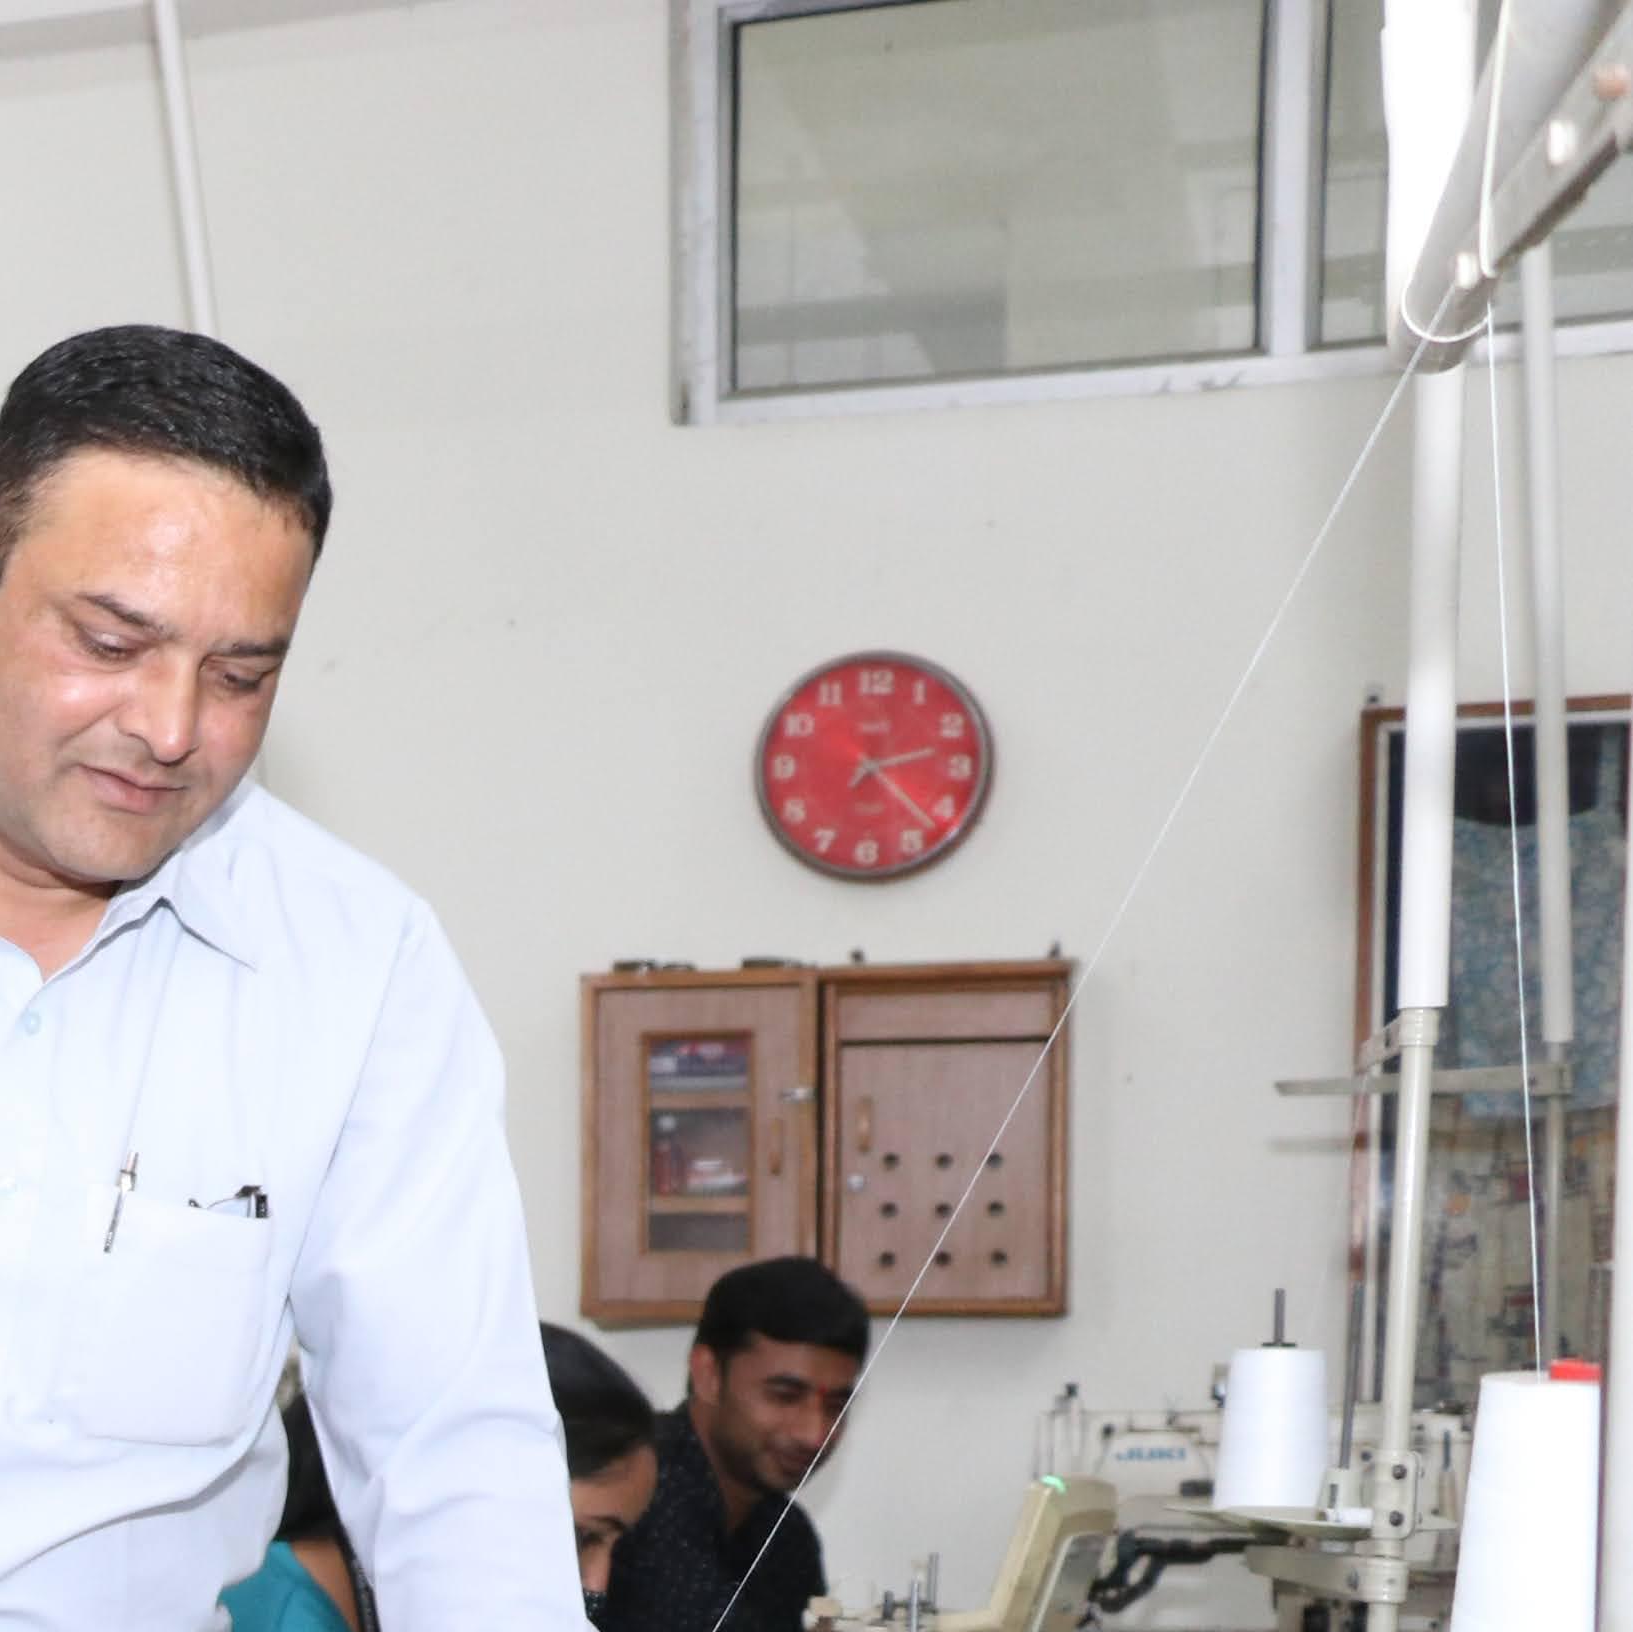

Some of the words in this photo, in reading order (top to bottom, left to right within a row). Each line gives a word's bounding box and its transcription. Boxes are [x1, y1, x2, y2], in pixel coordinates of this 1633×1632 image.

[818, 680, 843, 706] 11
[858, 669, 894, 696] 12
[913, 679, 927, 705] 1
[784, 712, 815, 737] 10
[940, 712, 965, 739] 2
[772, 754, 797, 781] 9
[948, 754, 973, 780] 3
[783, 798, 807, 825] 8
[932, 795, 955, 820] 4
[814, 827, 837, 853] 7
[853, 839, 879, 865] 6
[899, 828, 924, 854] 5
